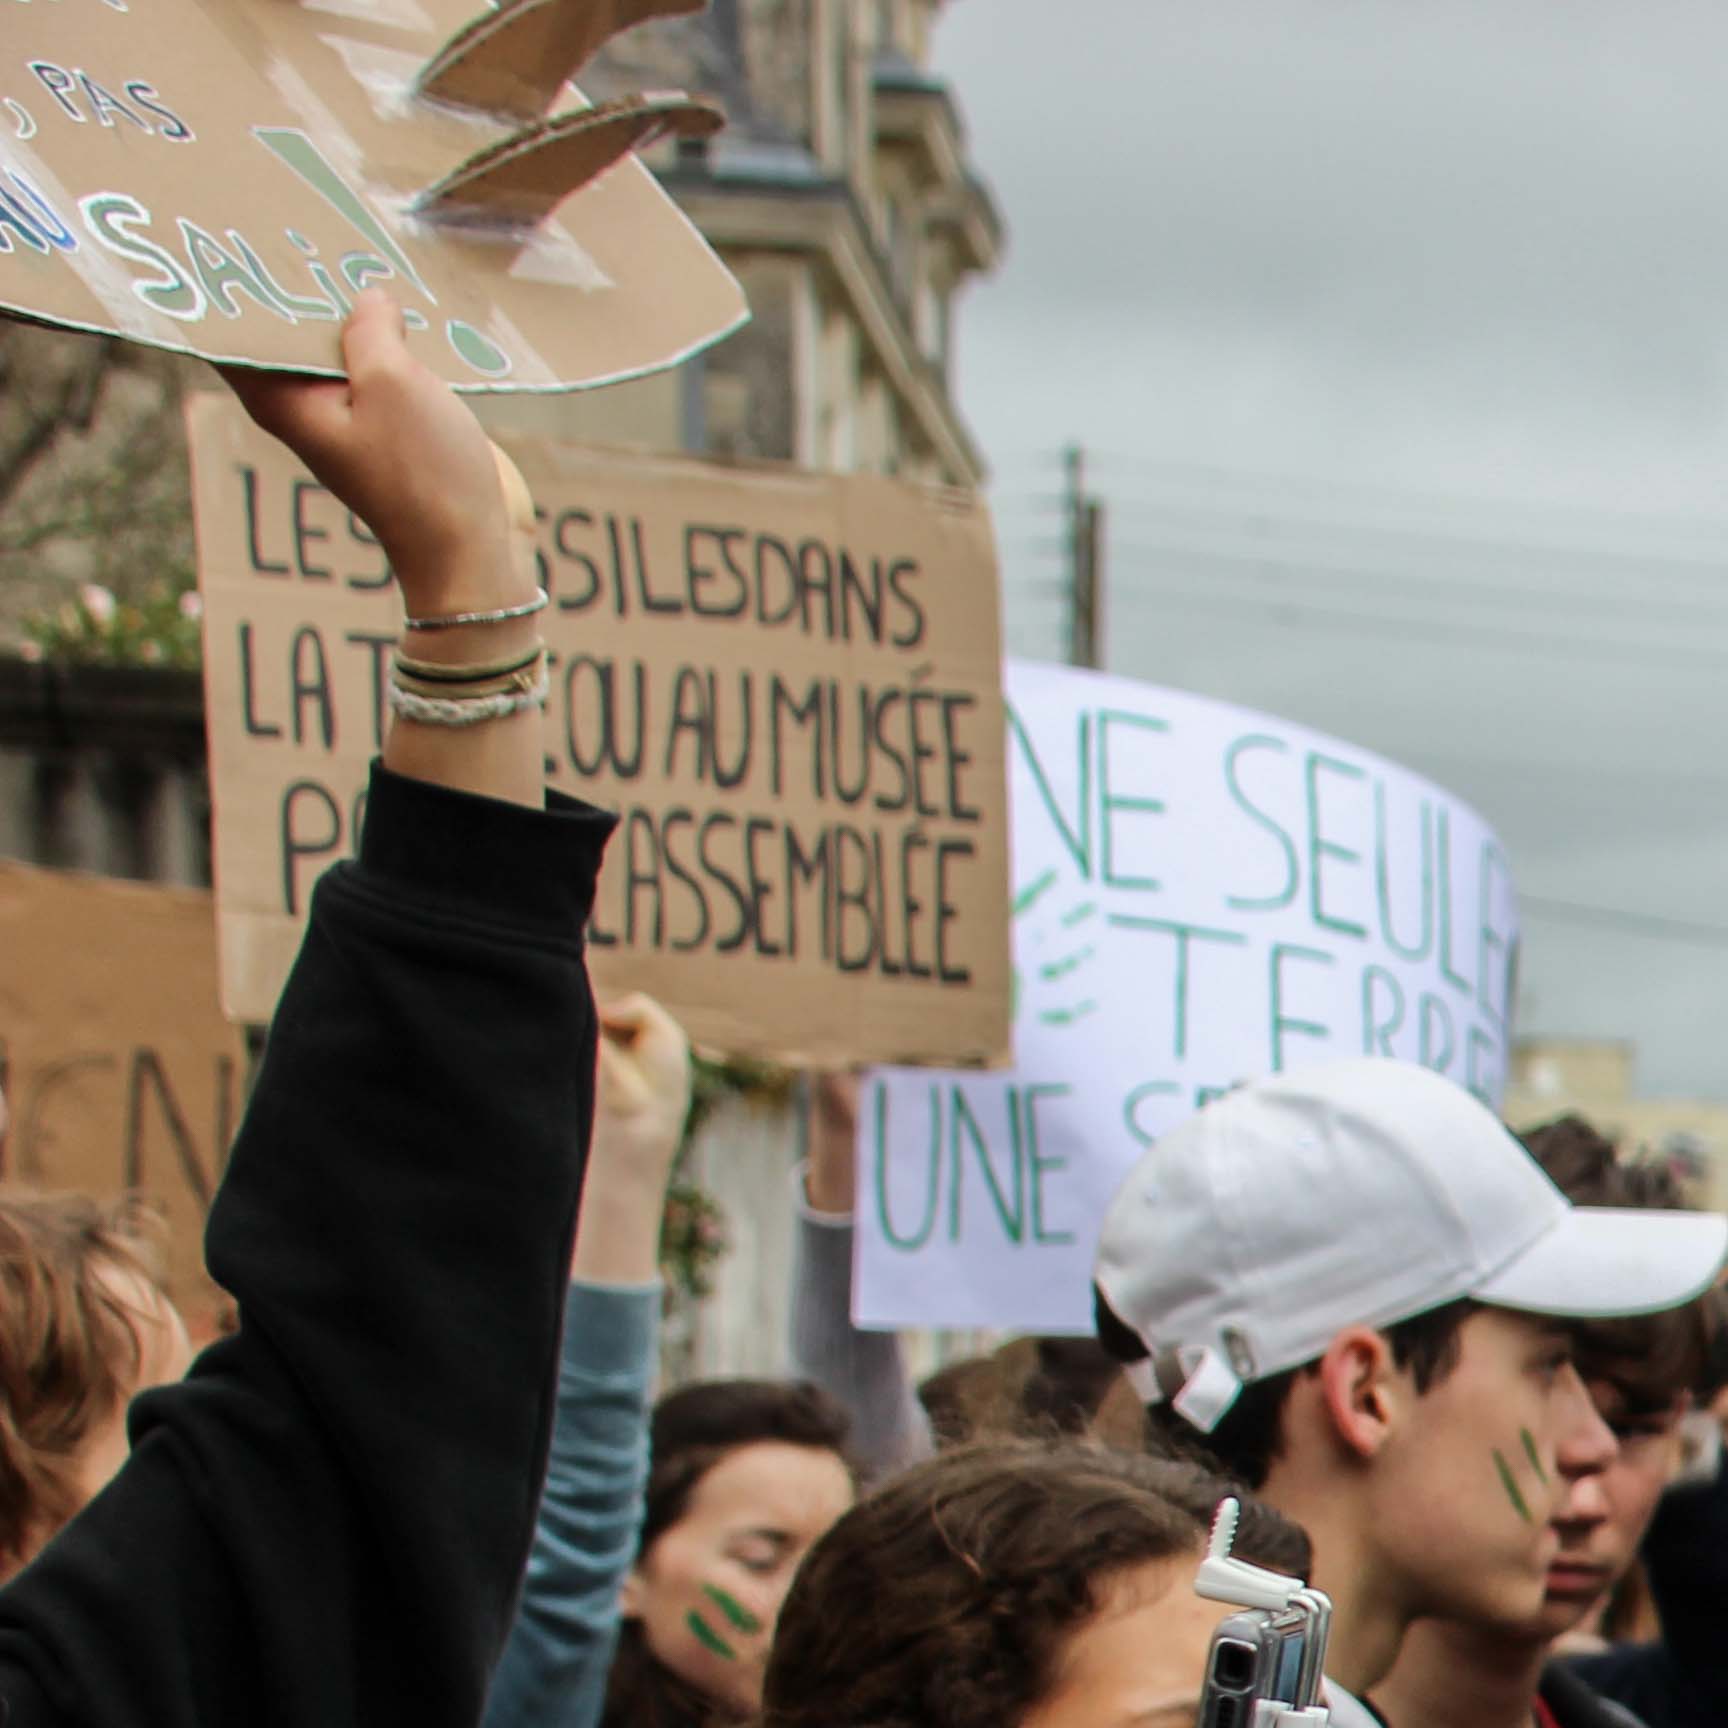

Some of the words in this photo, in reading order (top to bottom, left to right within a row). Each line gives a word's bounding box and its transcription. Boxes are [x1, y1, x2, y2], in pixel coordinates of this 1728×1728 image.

[27, 59, 197, 142] PAS
[238, 620, 334, 752] LA
[1003, 705, 1170, 892] NE
[873, 1080, 1076, 1252] UNE
